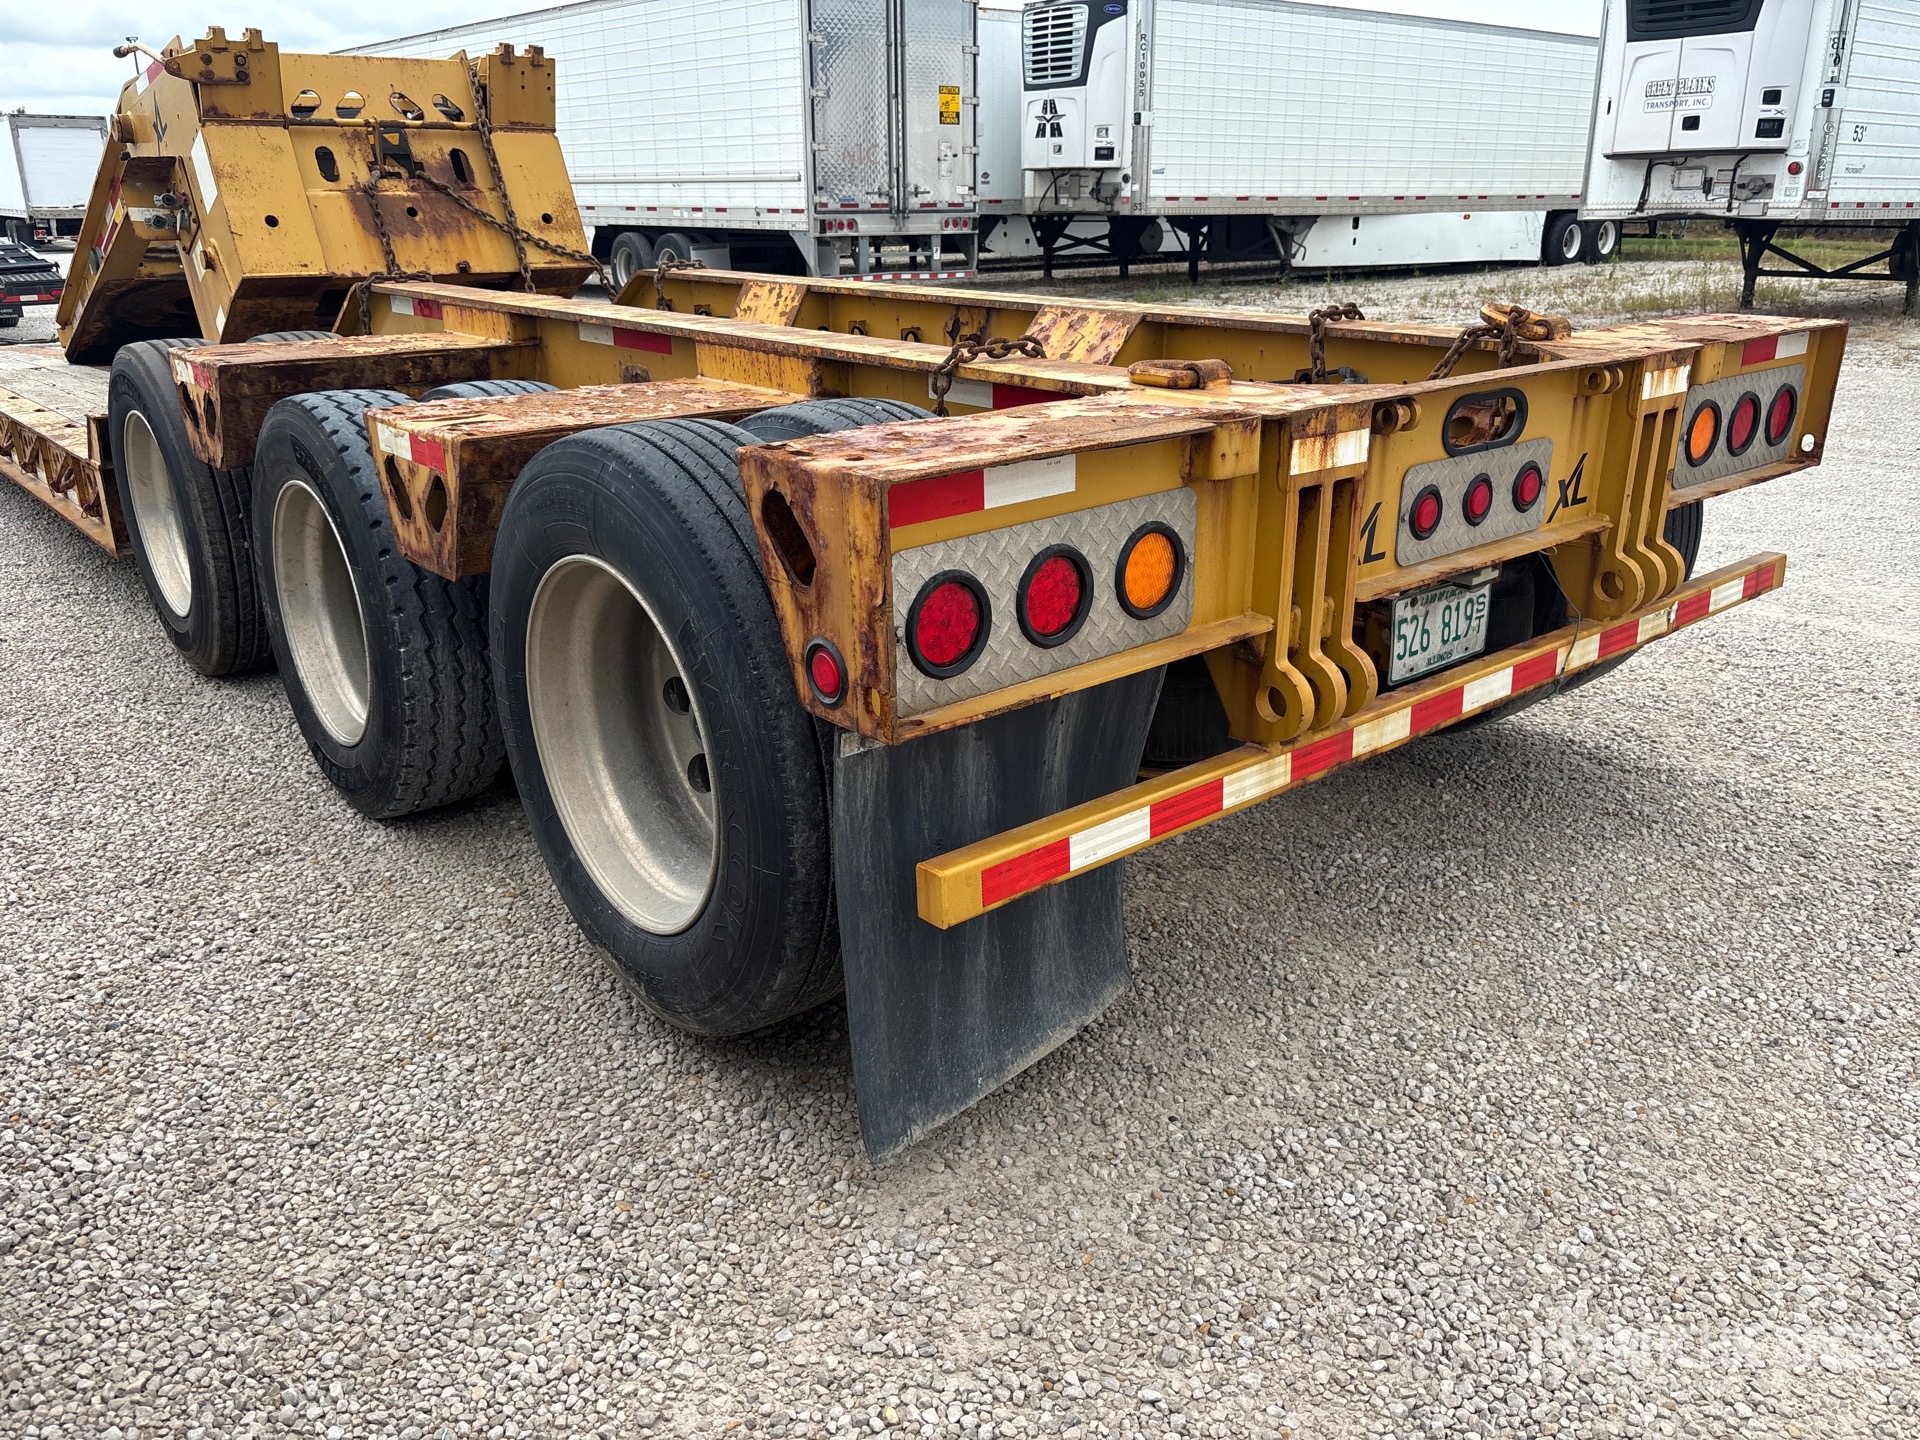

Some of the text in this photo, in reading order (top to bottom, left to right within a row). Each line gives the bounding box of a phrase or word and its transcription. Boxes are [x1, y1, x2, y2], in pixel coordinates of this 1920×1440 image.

[1139, 33, 1147, 97] RC10055
[1645, 75, 1717, 98] GREAT PLAINS
[1646, 97, 1709, 109] TRANSPORT, INC.
[1852, 124, 1868, 143] 53'
[1817, 120, 1835, 182] G1224
[1546, 452, 1588, 524] XL
[1420, 593, 1437, 607] LAND
[1437, 590, 1446, 602] OF
[1396, 596, 1475, 661] 526 819
[1426, 649, 1454, 666] ILLINOIS
